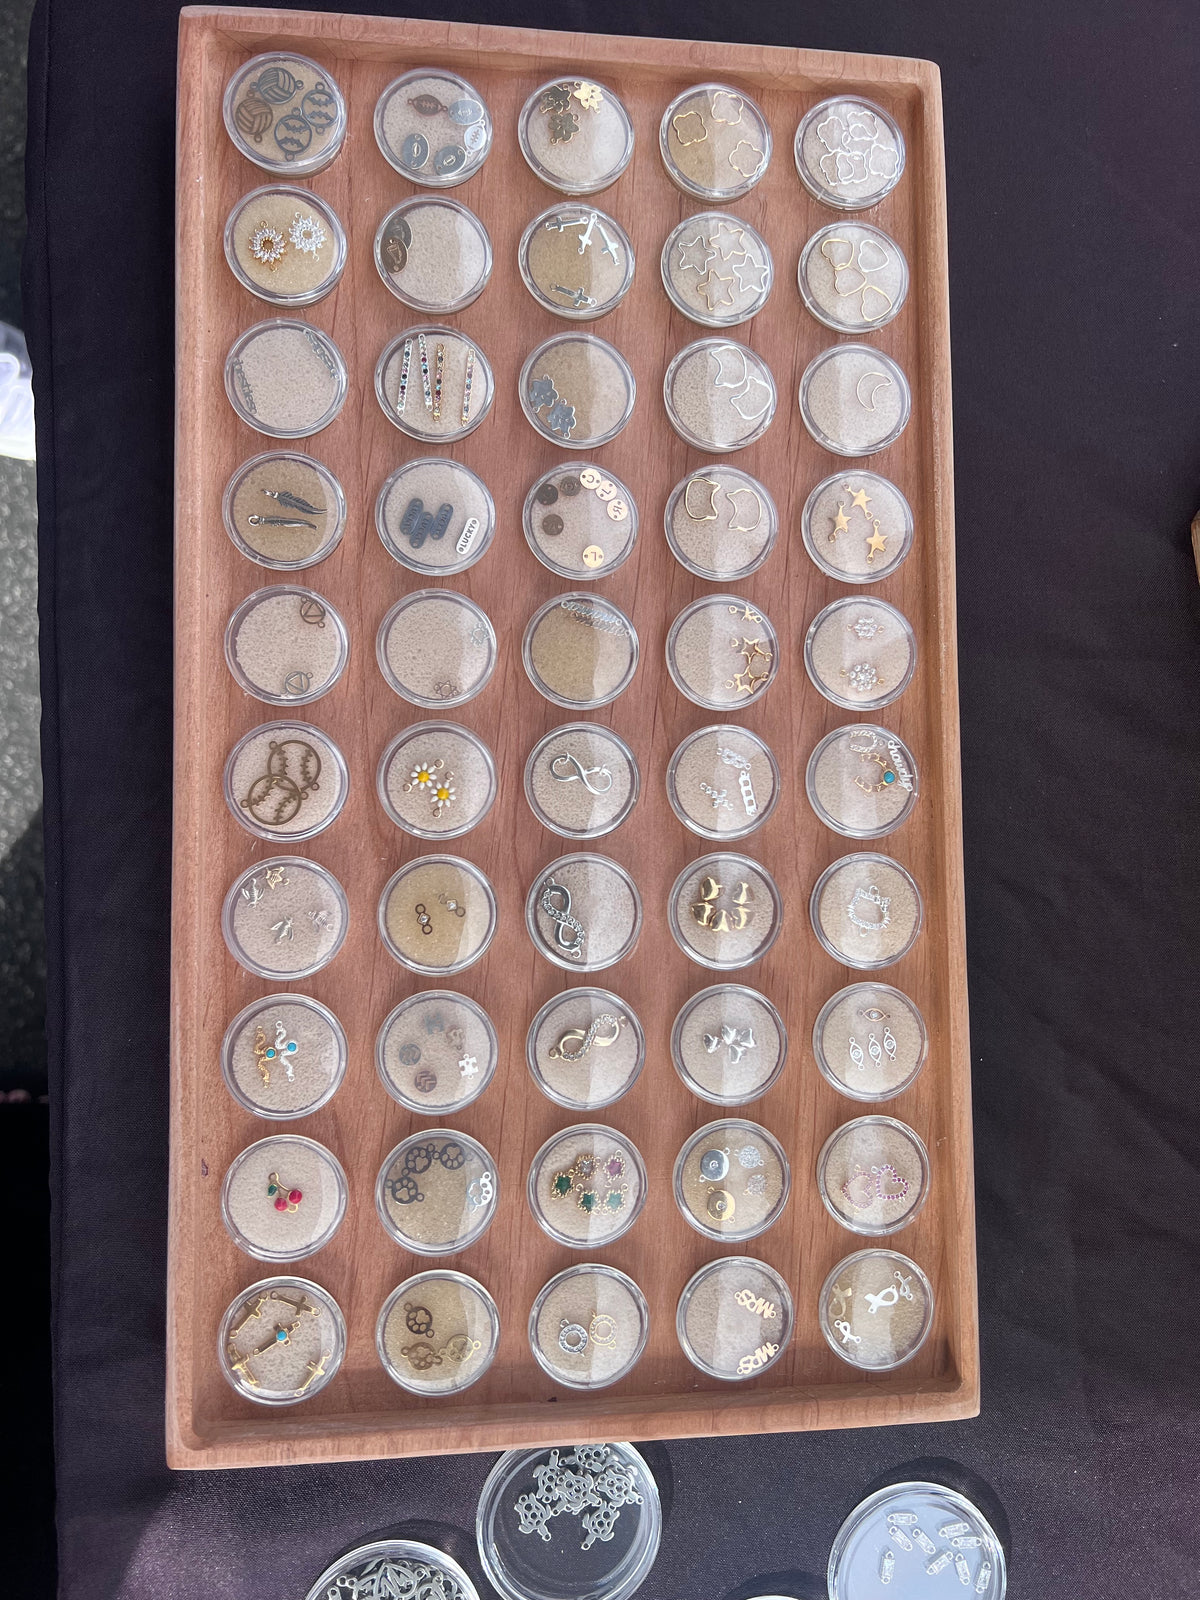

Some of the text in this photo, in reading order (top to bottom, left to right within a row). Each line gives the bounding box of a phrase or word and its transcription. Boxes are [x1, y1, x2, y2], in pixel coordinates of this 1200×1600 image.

[586, 474, 595, 484] C
[461, 522, 477, 548] LUCKY
[590, 551, 597, 561] L
[888, 743, 913, 787] howdy
[737, 1289, 775, 1318] MRS
[739, 1342, 776, 1374] MRS
